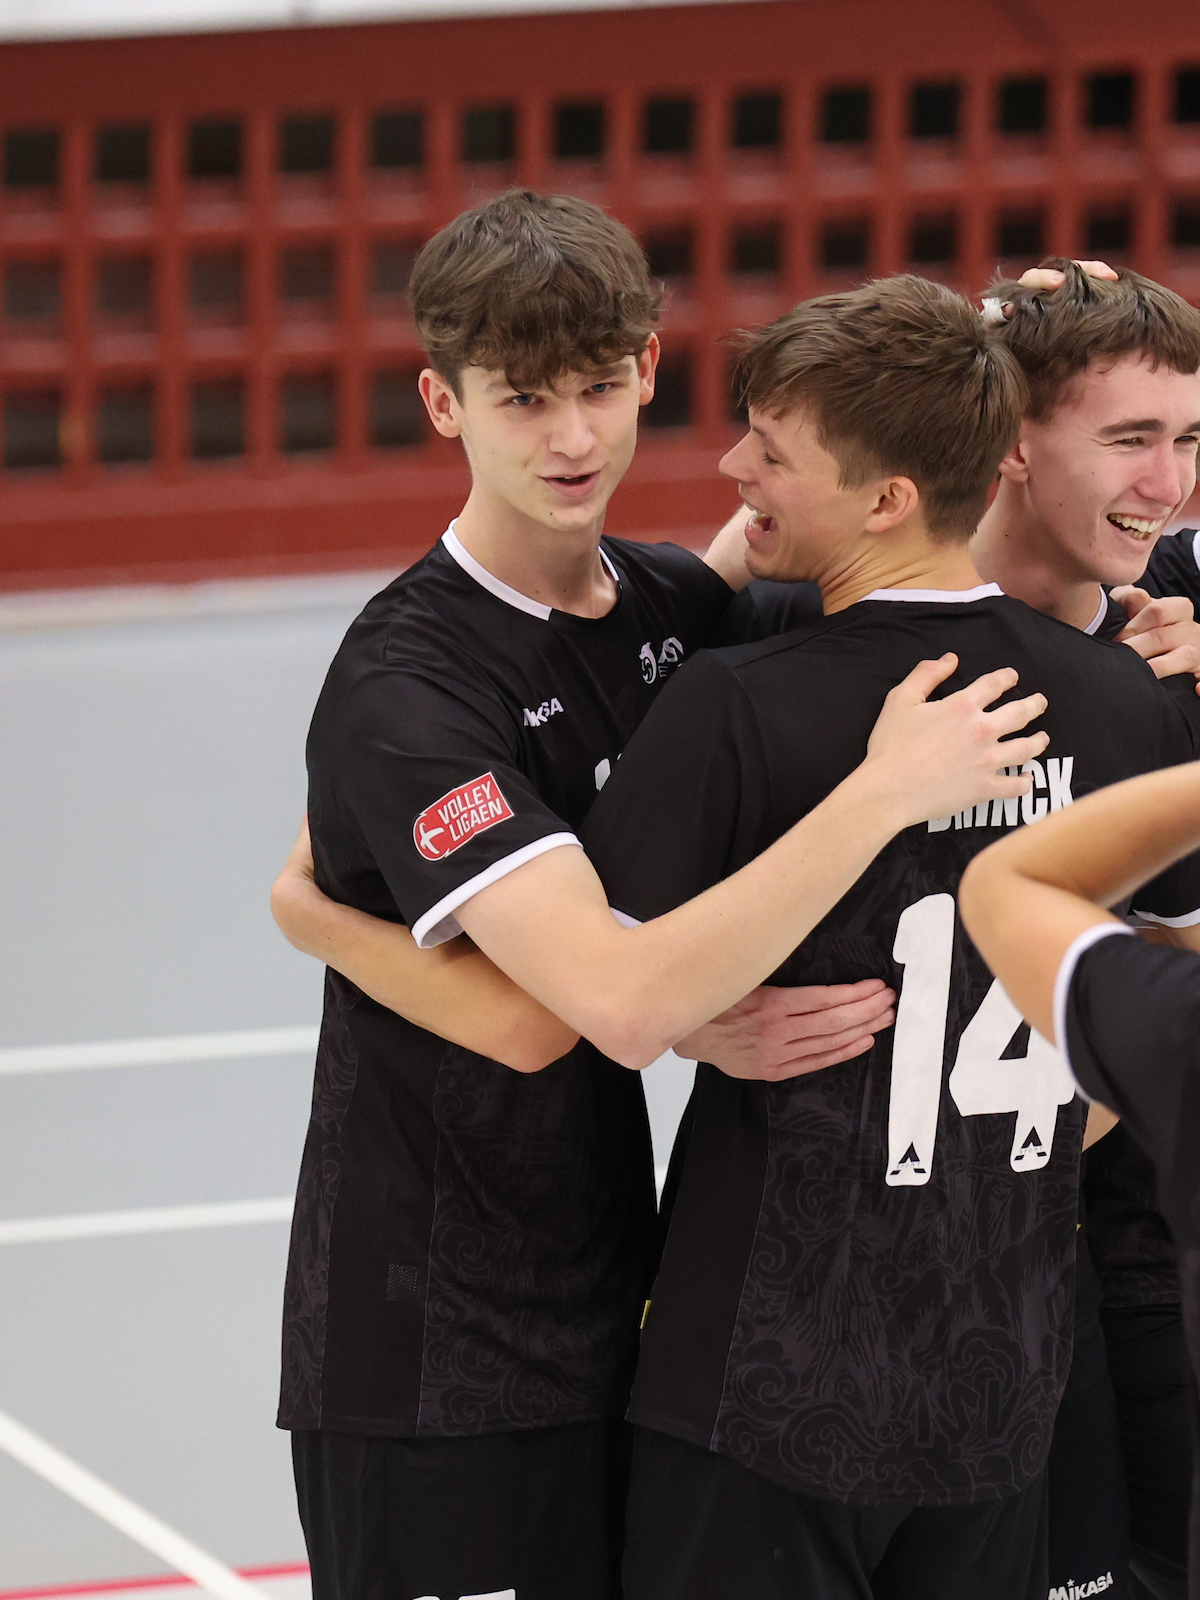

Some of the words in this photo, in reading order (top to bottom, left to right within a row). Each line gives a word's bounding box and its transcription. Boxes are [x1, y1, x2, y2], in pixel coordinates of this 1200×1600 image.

[437, 781, 491, 825] VOLLEY
[449, 797, 503, 842] LIGAEN
[885, 893, 1076, 1186] 14
